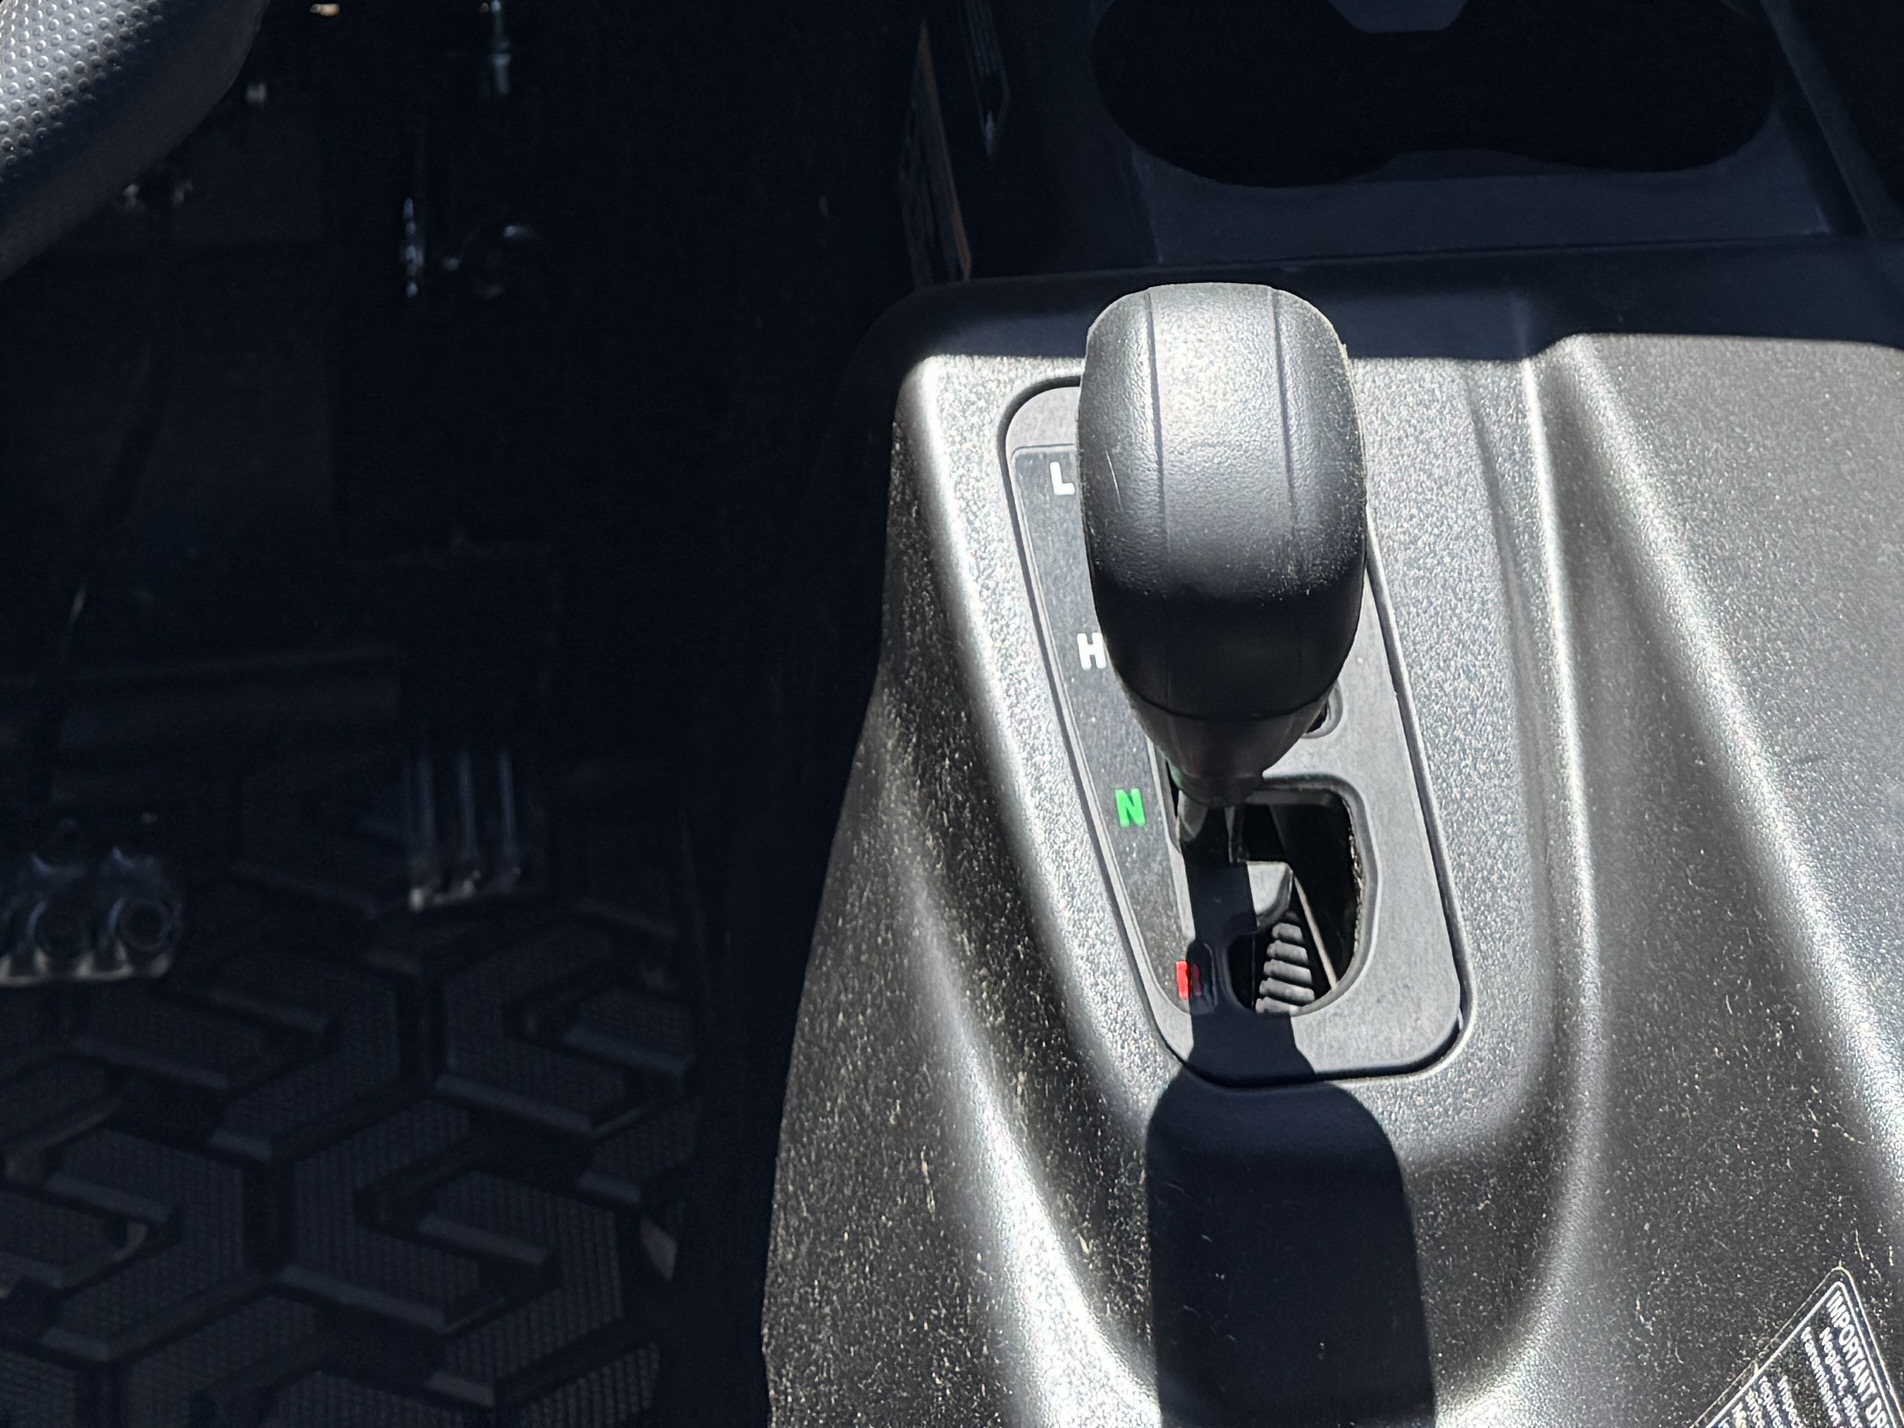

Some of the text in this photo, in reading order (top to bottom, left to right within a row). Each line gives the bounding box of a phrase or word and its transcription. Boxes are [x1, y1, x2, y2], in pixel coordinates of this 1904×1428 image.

[1050, 461, 1076, 495] L
[1076, 632, 1107, 670] H
[1114, 788, 1146, 828] N
[1800, 1326, 1841, 1427] transmission
[1819, 1327, 1849, 1396] Neglect,
[1826, 1290, 1890, 1428] IMPORTANT DR
